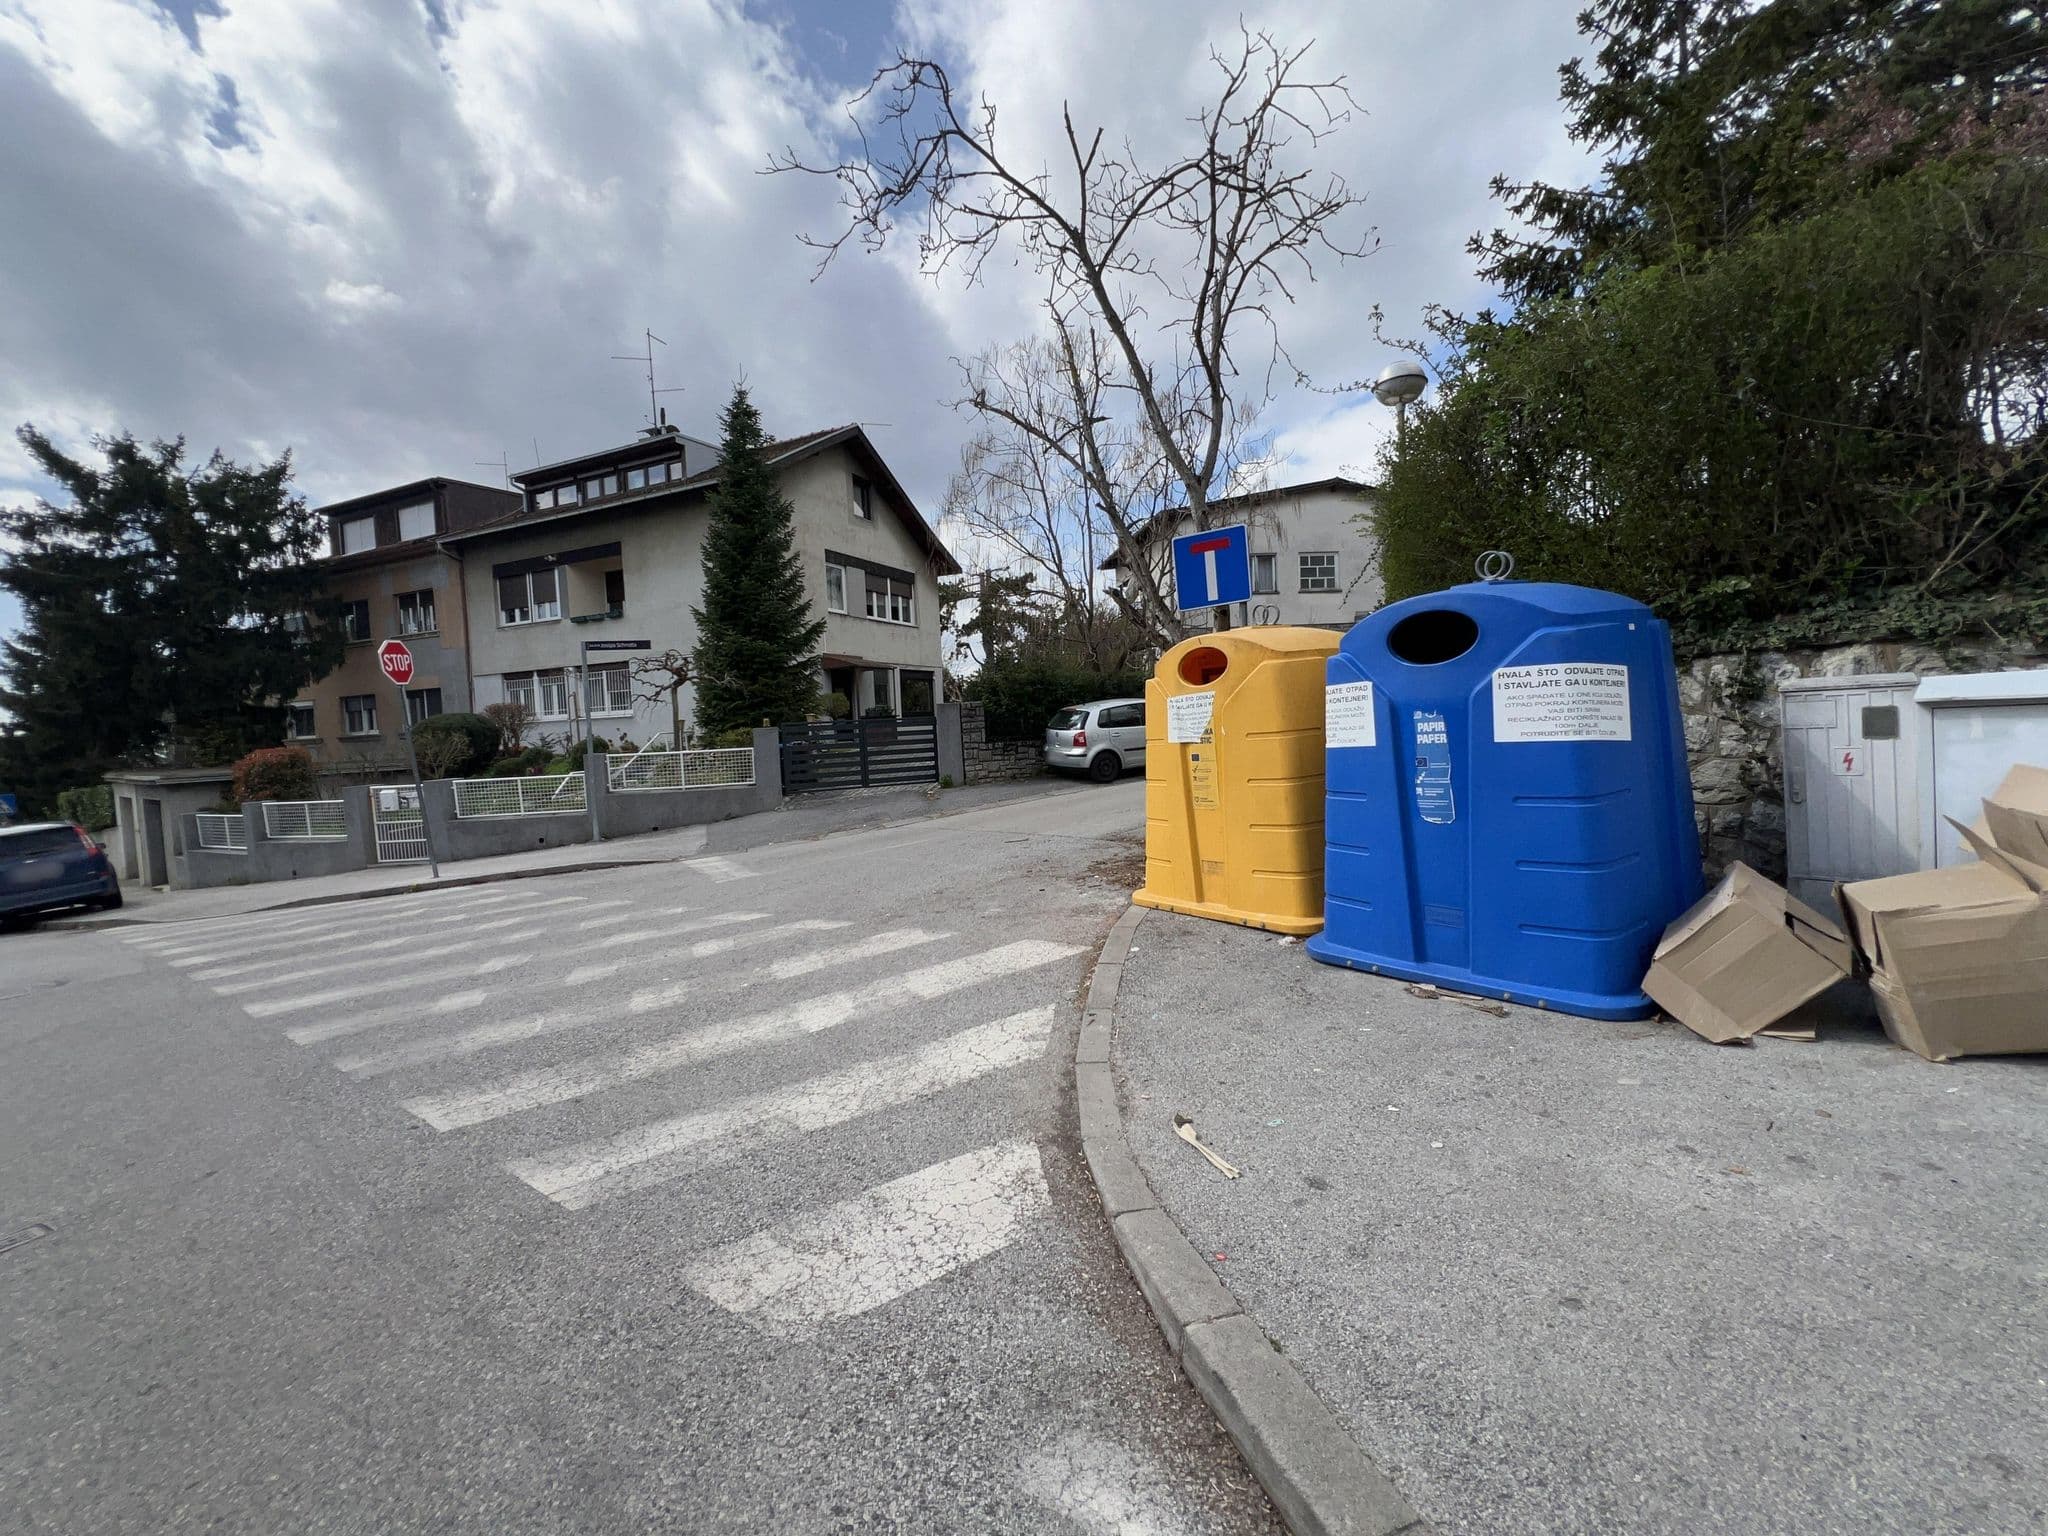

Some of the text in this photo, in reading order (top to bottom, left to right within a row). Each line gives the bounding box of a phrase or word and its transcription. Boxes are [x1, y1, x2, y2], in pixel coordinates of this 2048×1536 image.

[383, 653, 410, 672] STOP
[1498, 667, 1625, 680] HVALA ŠTO ODVAJATE OTPAD
[1346, 685, 1368, 693] OTPAD
[1504, 679, 1562, 690] STAVLJATE
[1565, 679, 1580, 687] GA
[1526, 692, 1565, 700] SPADATE
[1417, 721, 1445, 733] PAPIR
[1417, 733, 1448, 745] PAPER
